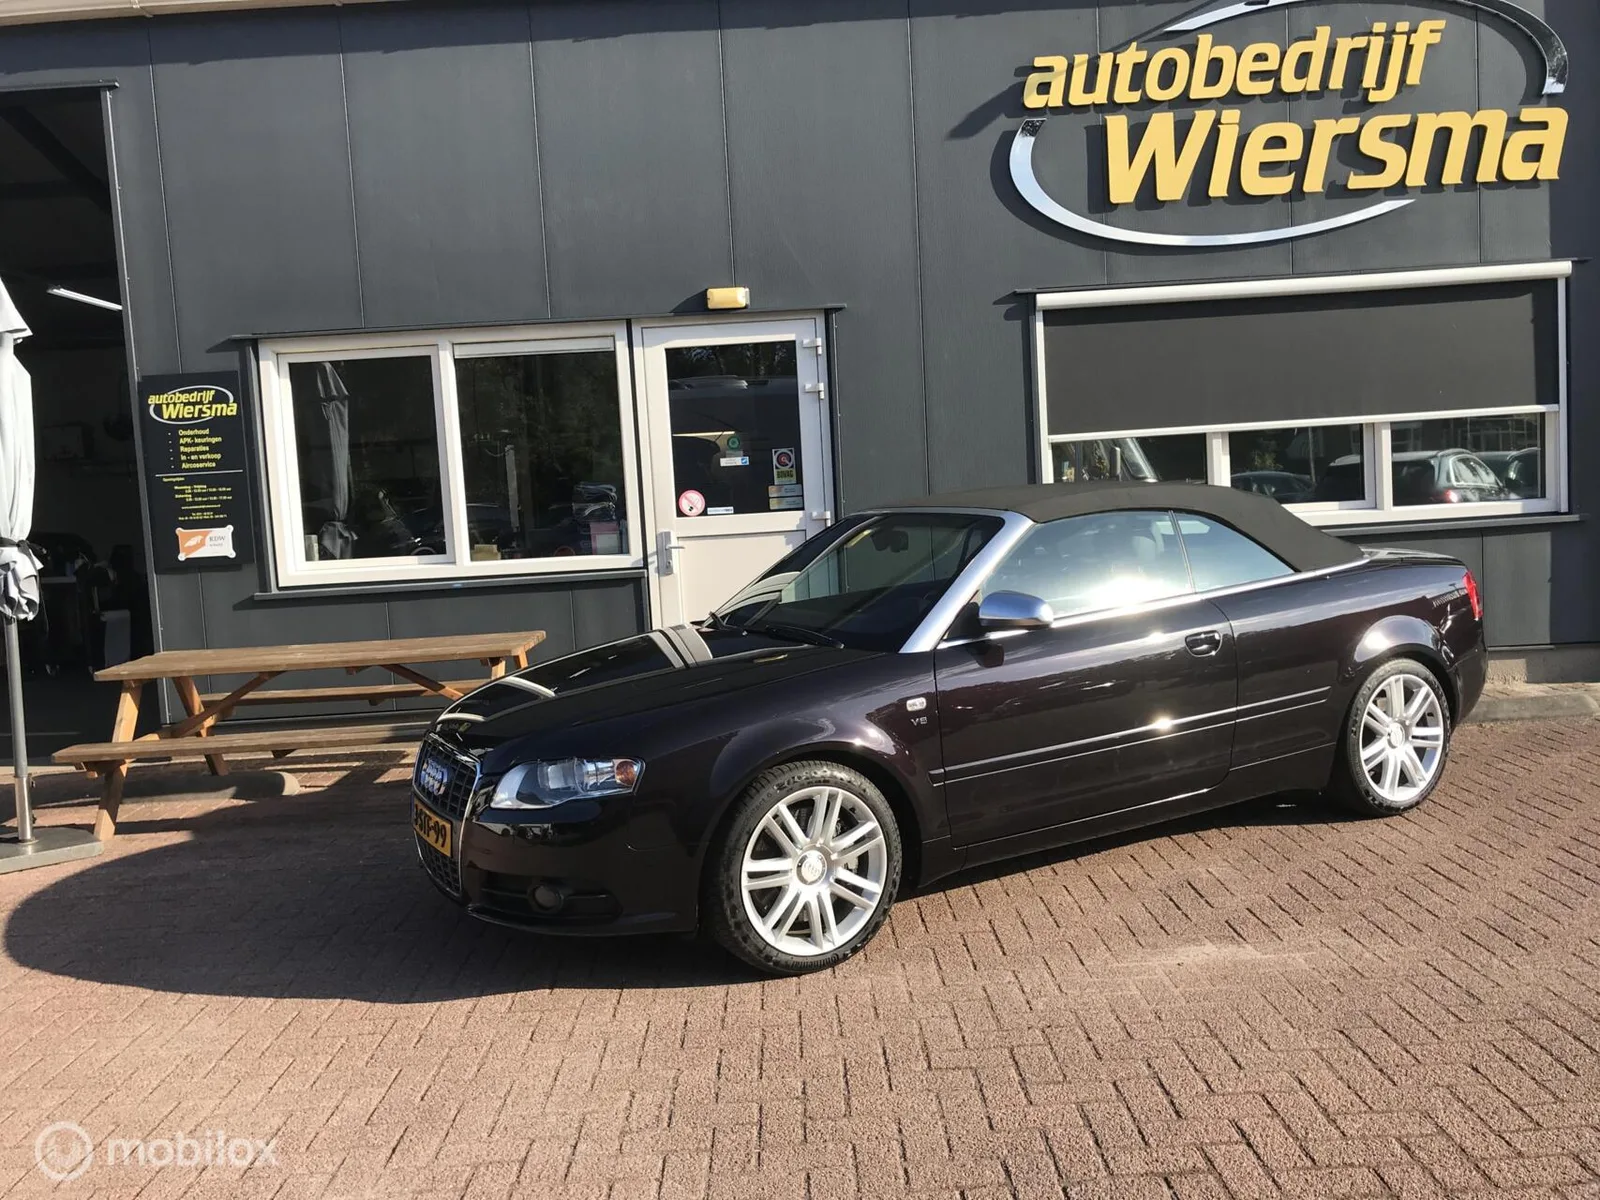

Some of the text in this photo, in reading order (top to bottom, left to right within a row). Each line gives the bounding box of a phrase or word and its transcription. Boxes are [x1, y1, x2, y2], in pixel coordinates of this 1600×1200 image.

[1022, 19, 1447, 109] autobedrijf
[1103, 106, 1569, 204] Wiersma
[147, 389, 215, 405] autobedrijf
[161, 402, 238, 420] Wiersma
[178, 428, 210, 436] Onderhoud
[182, 461, 216, 469] Aircoservice
